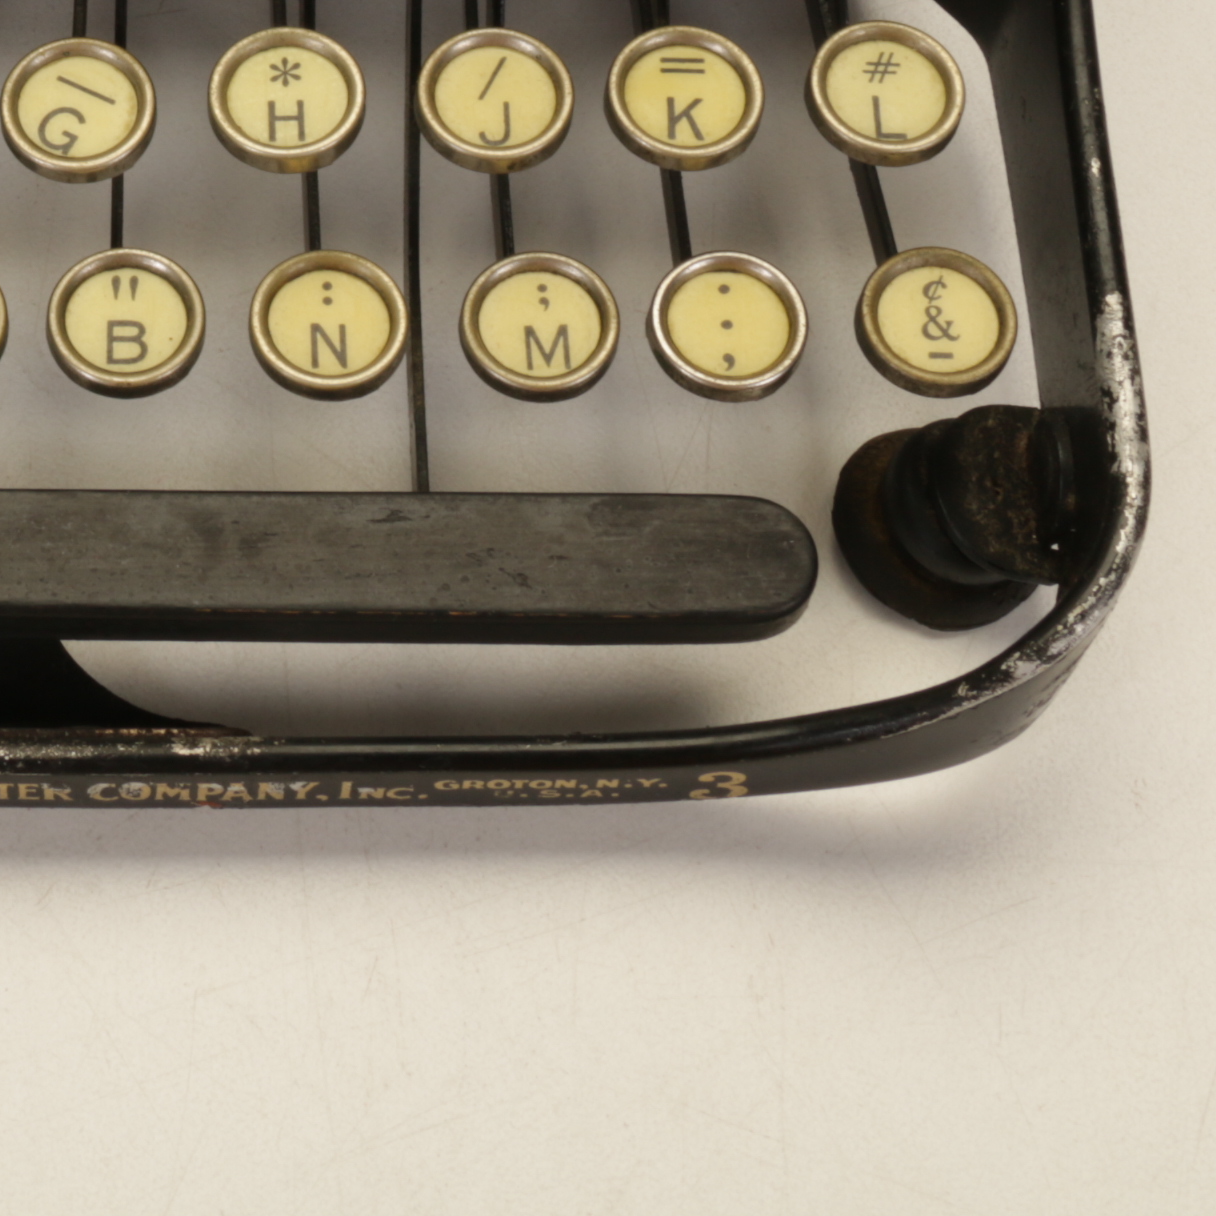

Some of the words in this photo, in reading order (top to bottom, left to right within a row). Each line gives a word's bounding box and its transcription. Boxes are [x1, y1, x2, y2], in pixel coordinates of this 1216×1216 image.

[863, 52, 900, 83] #
[37, 107, 87, 154] G
[268, 100, 306, 142] H
[478, 101, 511, 146] J
[667, 97, 704, 141] K
[871, 95, 907, 140] L
[106, 320, 148, 365] B
[921, 305, 960, 341] &
[310, 323, 348, 369] N
[524, 324, 573, 371] M
[434, 778, 589, 790] GROTON,
[689, 771, 748, 800] 3
